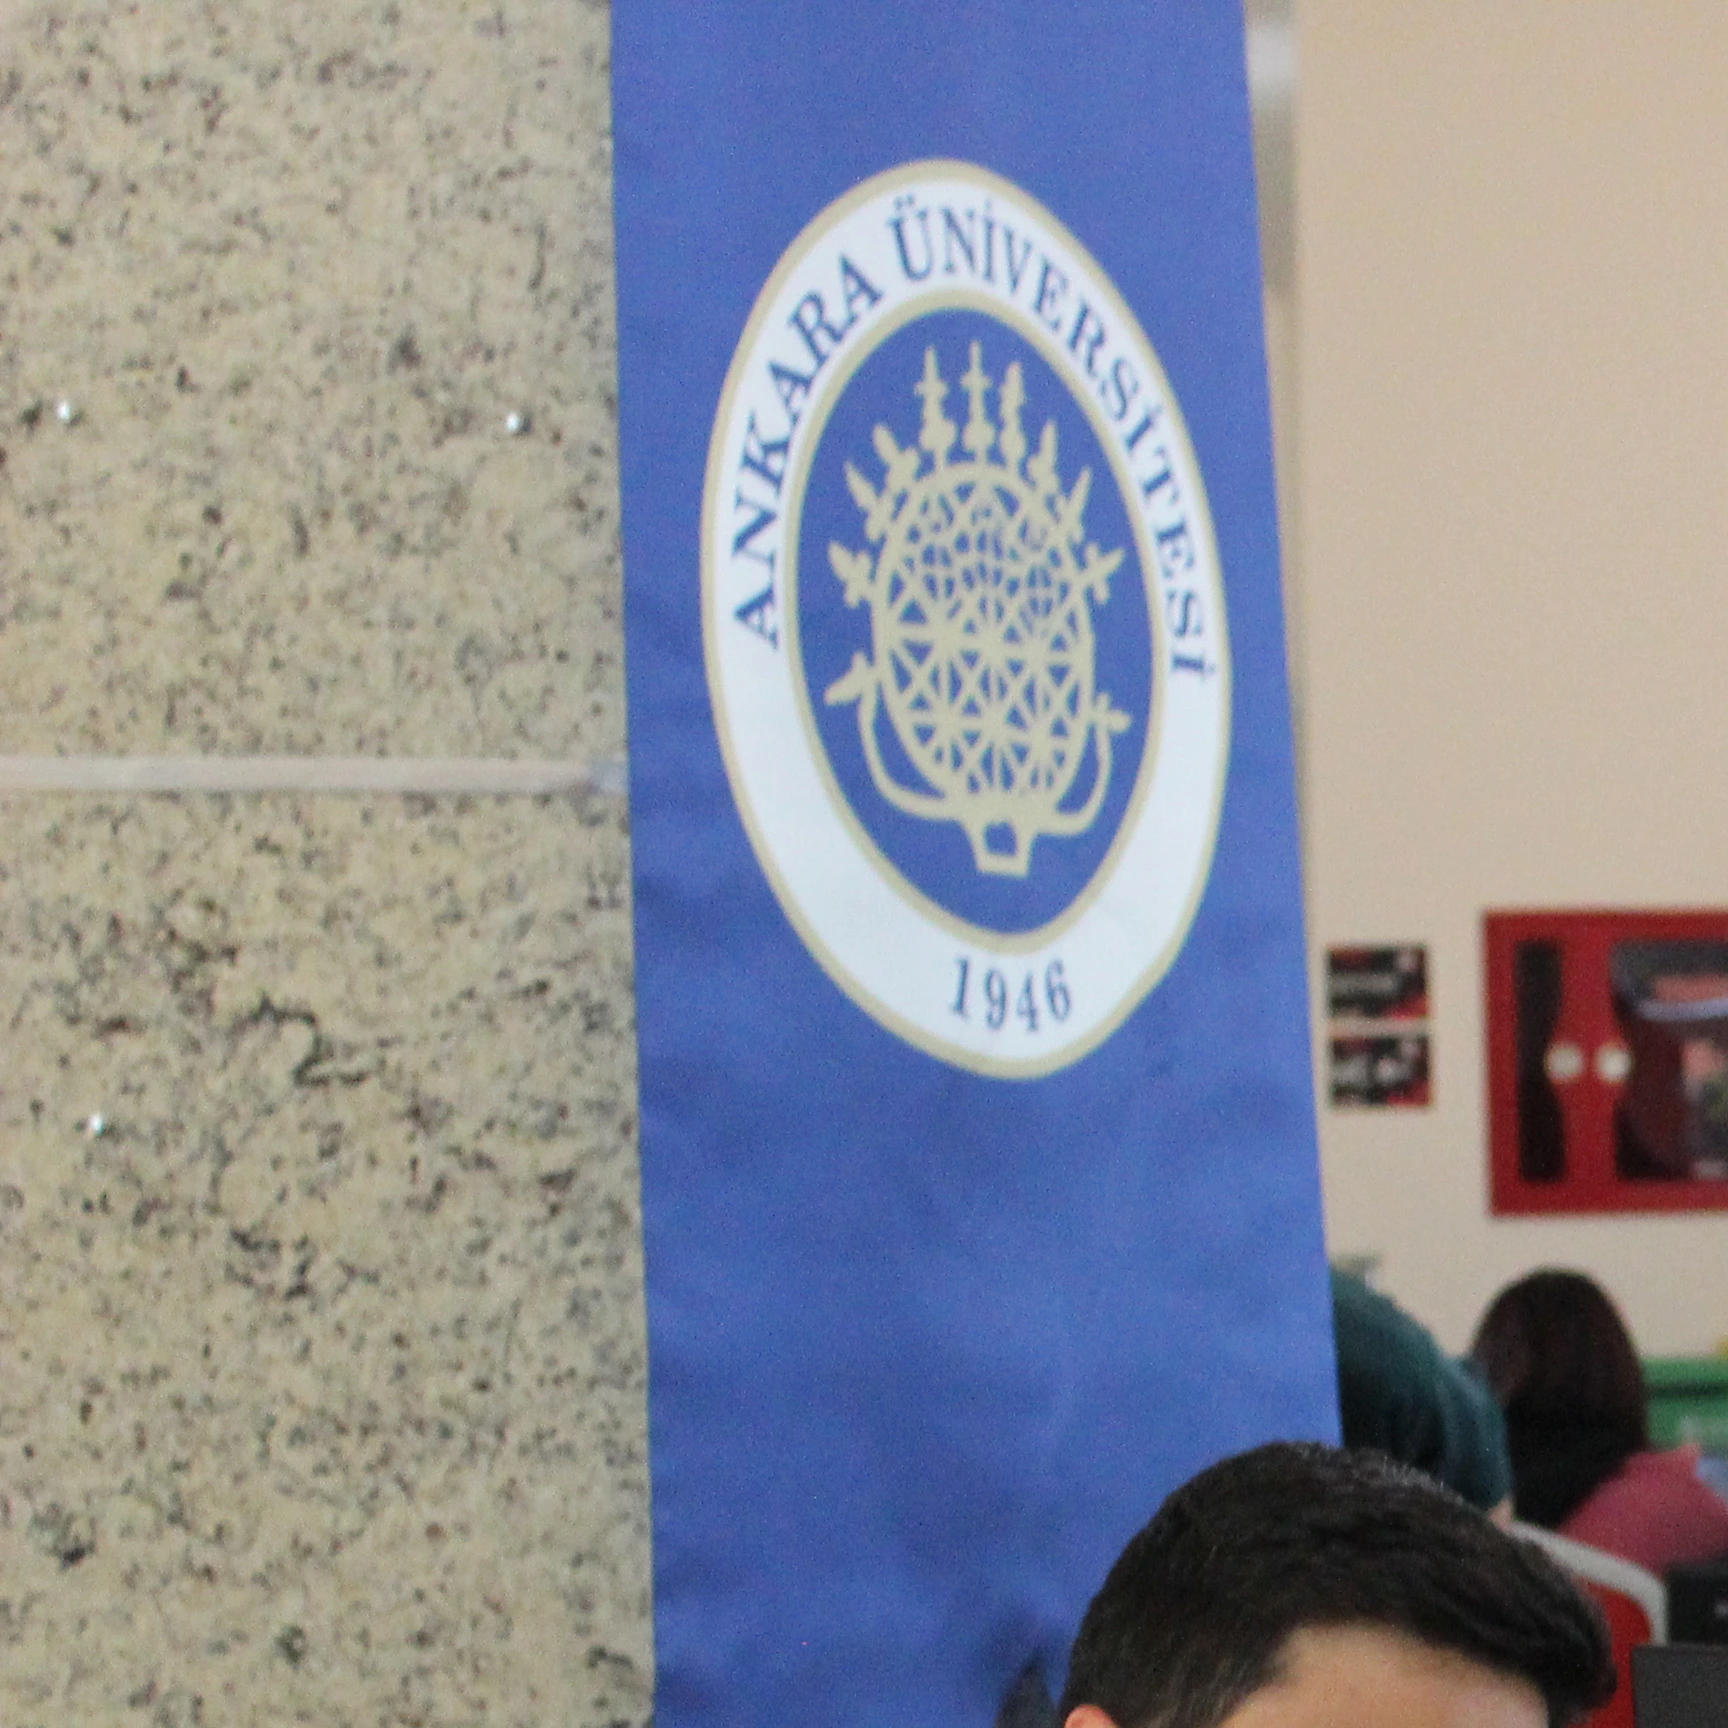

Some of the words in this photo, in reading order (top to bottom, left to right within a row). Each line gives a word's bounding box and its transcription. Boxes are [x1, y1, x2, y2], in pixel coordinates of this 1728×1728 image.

[729, 253, 883, 650] ANKARA
[889, 192, 1220, 686] ÜNİVERSİTESİ
[949, 956, 1074, 1034] 1946
